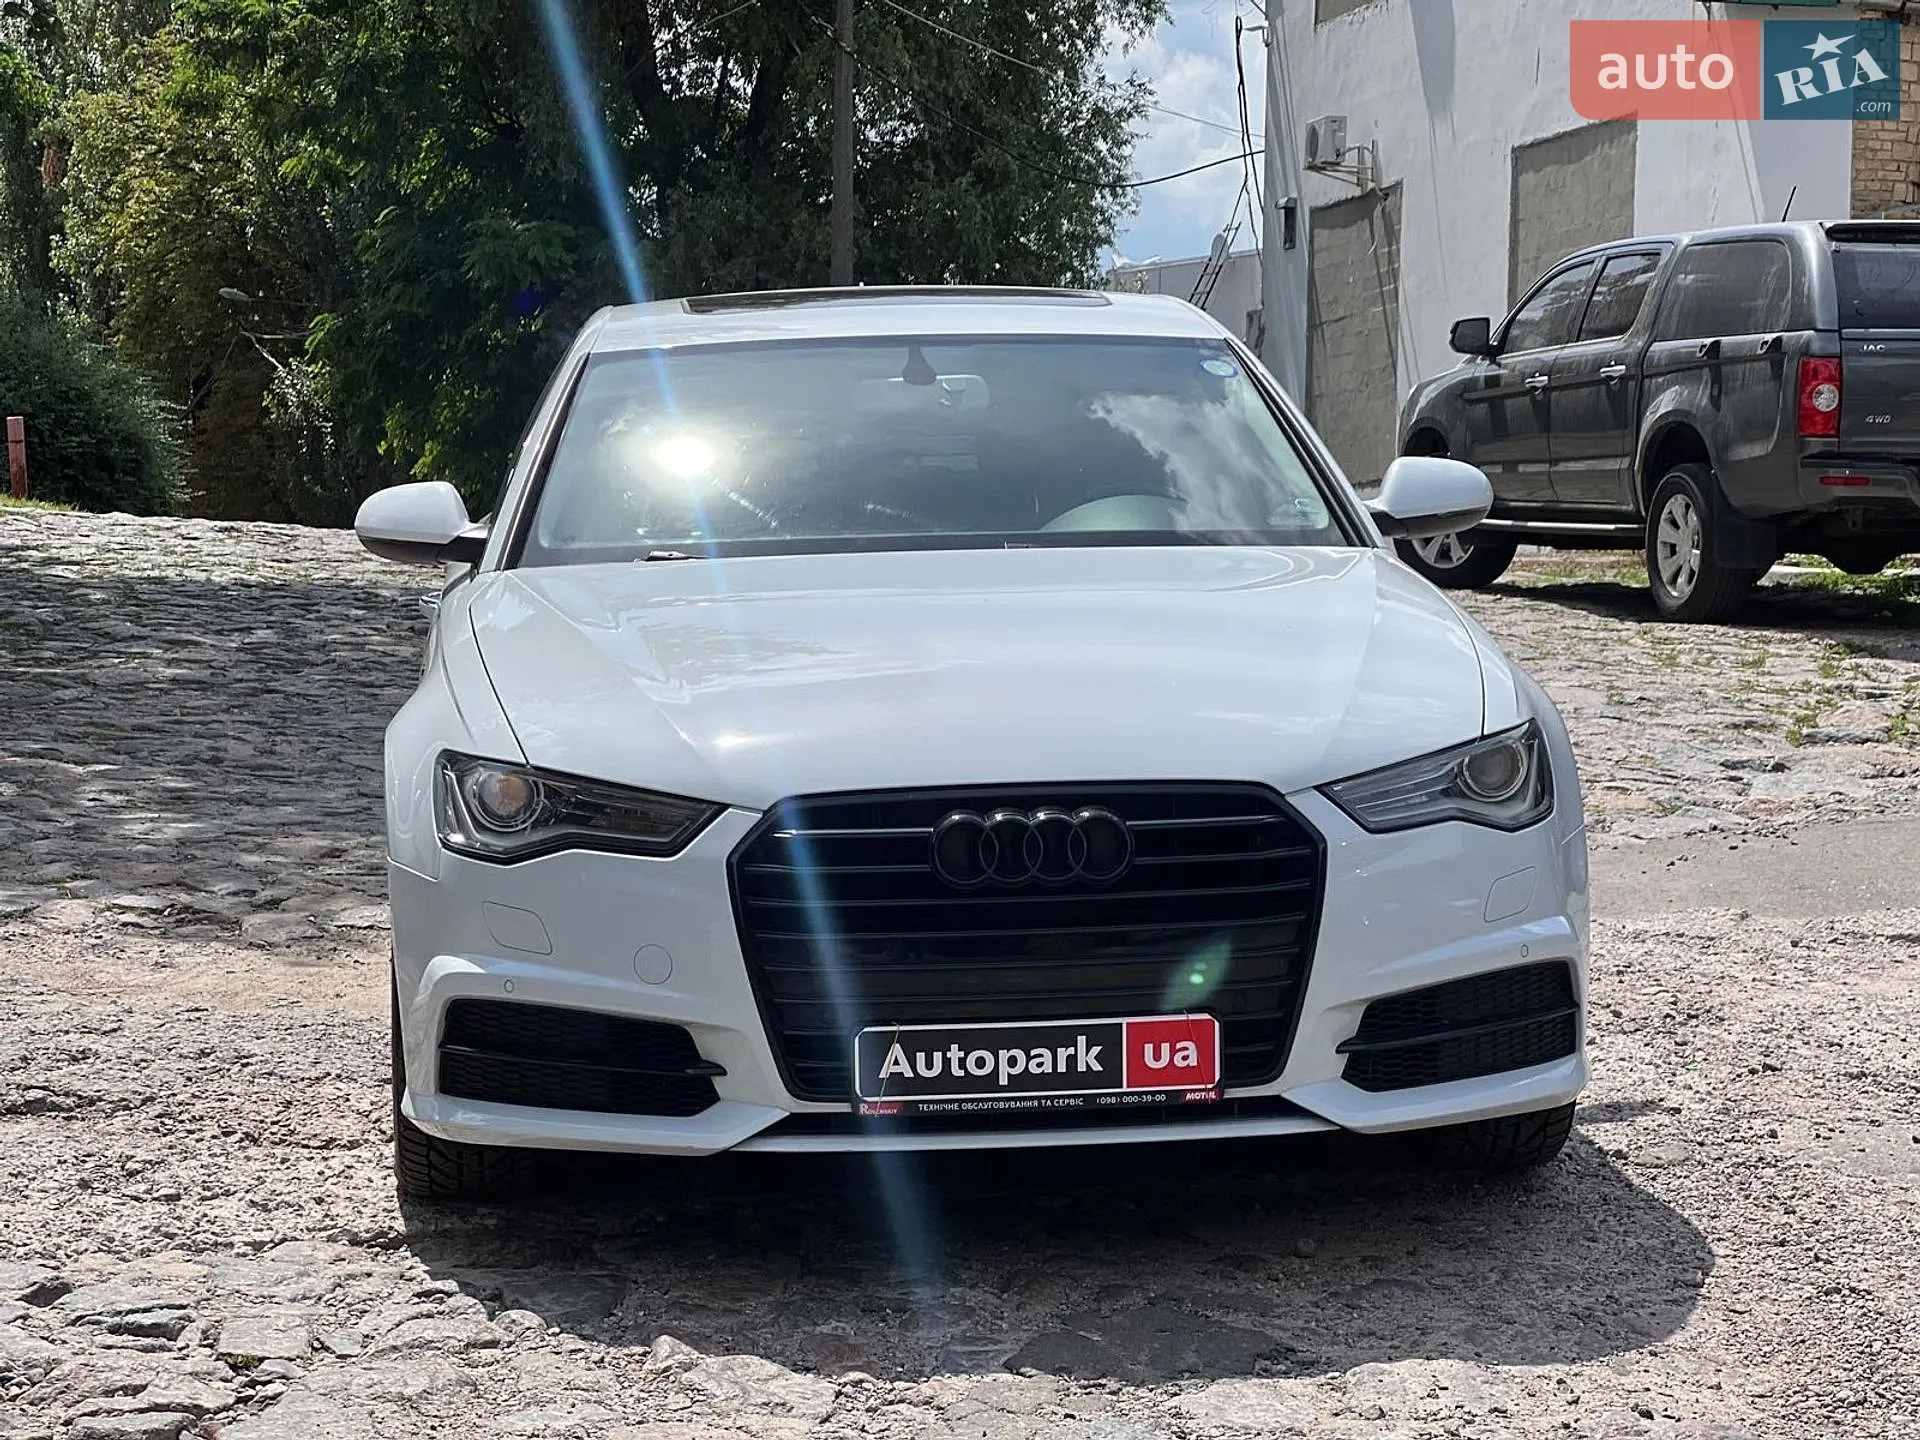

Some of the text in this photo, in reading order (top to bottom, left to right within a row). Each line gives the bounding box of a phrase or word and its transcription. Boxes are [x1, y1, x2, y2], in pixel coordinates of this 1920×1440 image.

[1861, 344, 1886, 352] JAC
[1865, 415, 1892, 424] 4WD
[878, 1035, 1199, 1086] Autopark ua
[1185, 1090, 1217, 1101] MOTUL
[918, 1094, 1166, 1111] ТЕХНІЧНЕ ОБСЛУГОВУВАННЯ ТА СЕРВІС (098) 000-39-00
